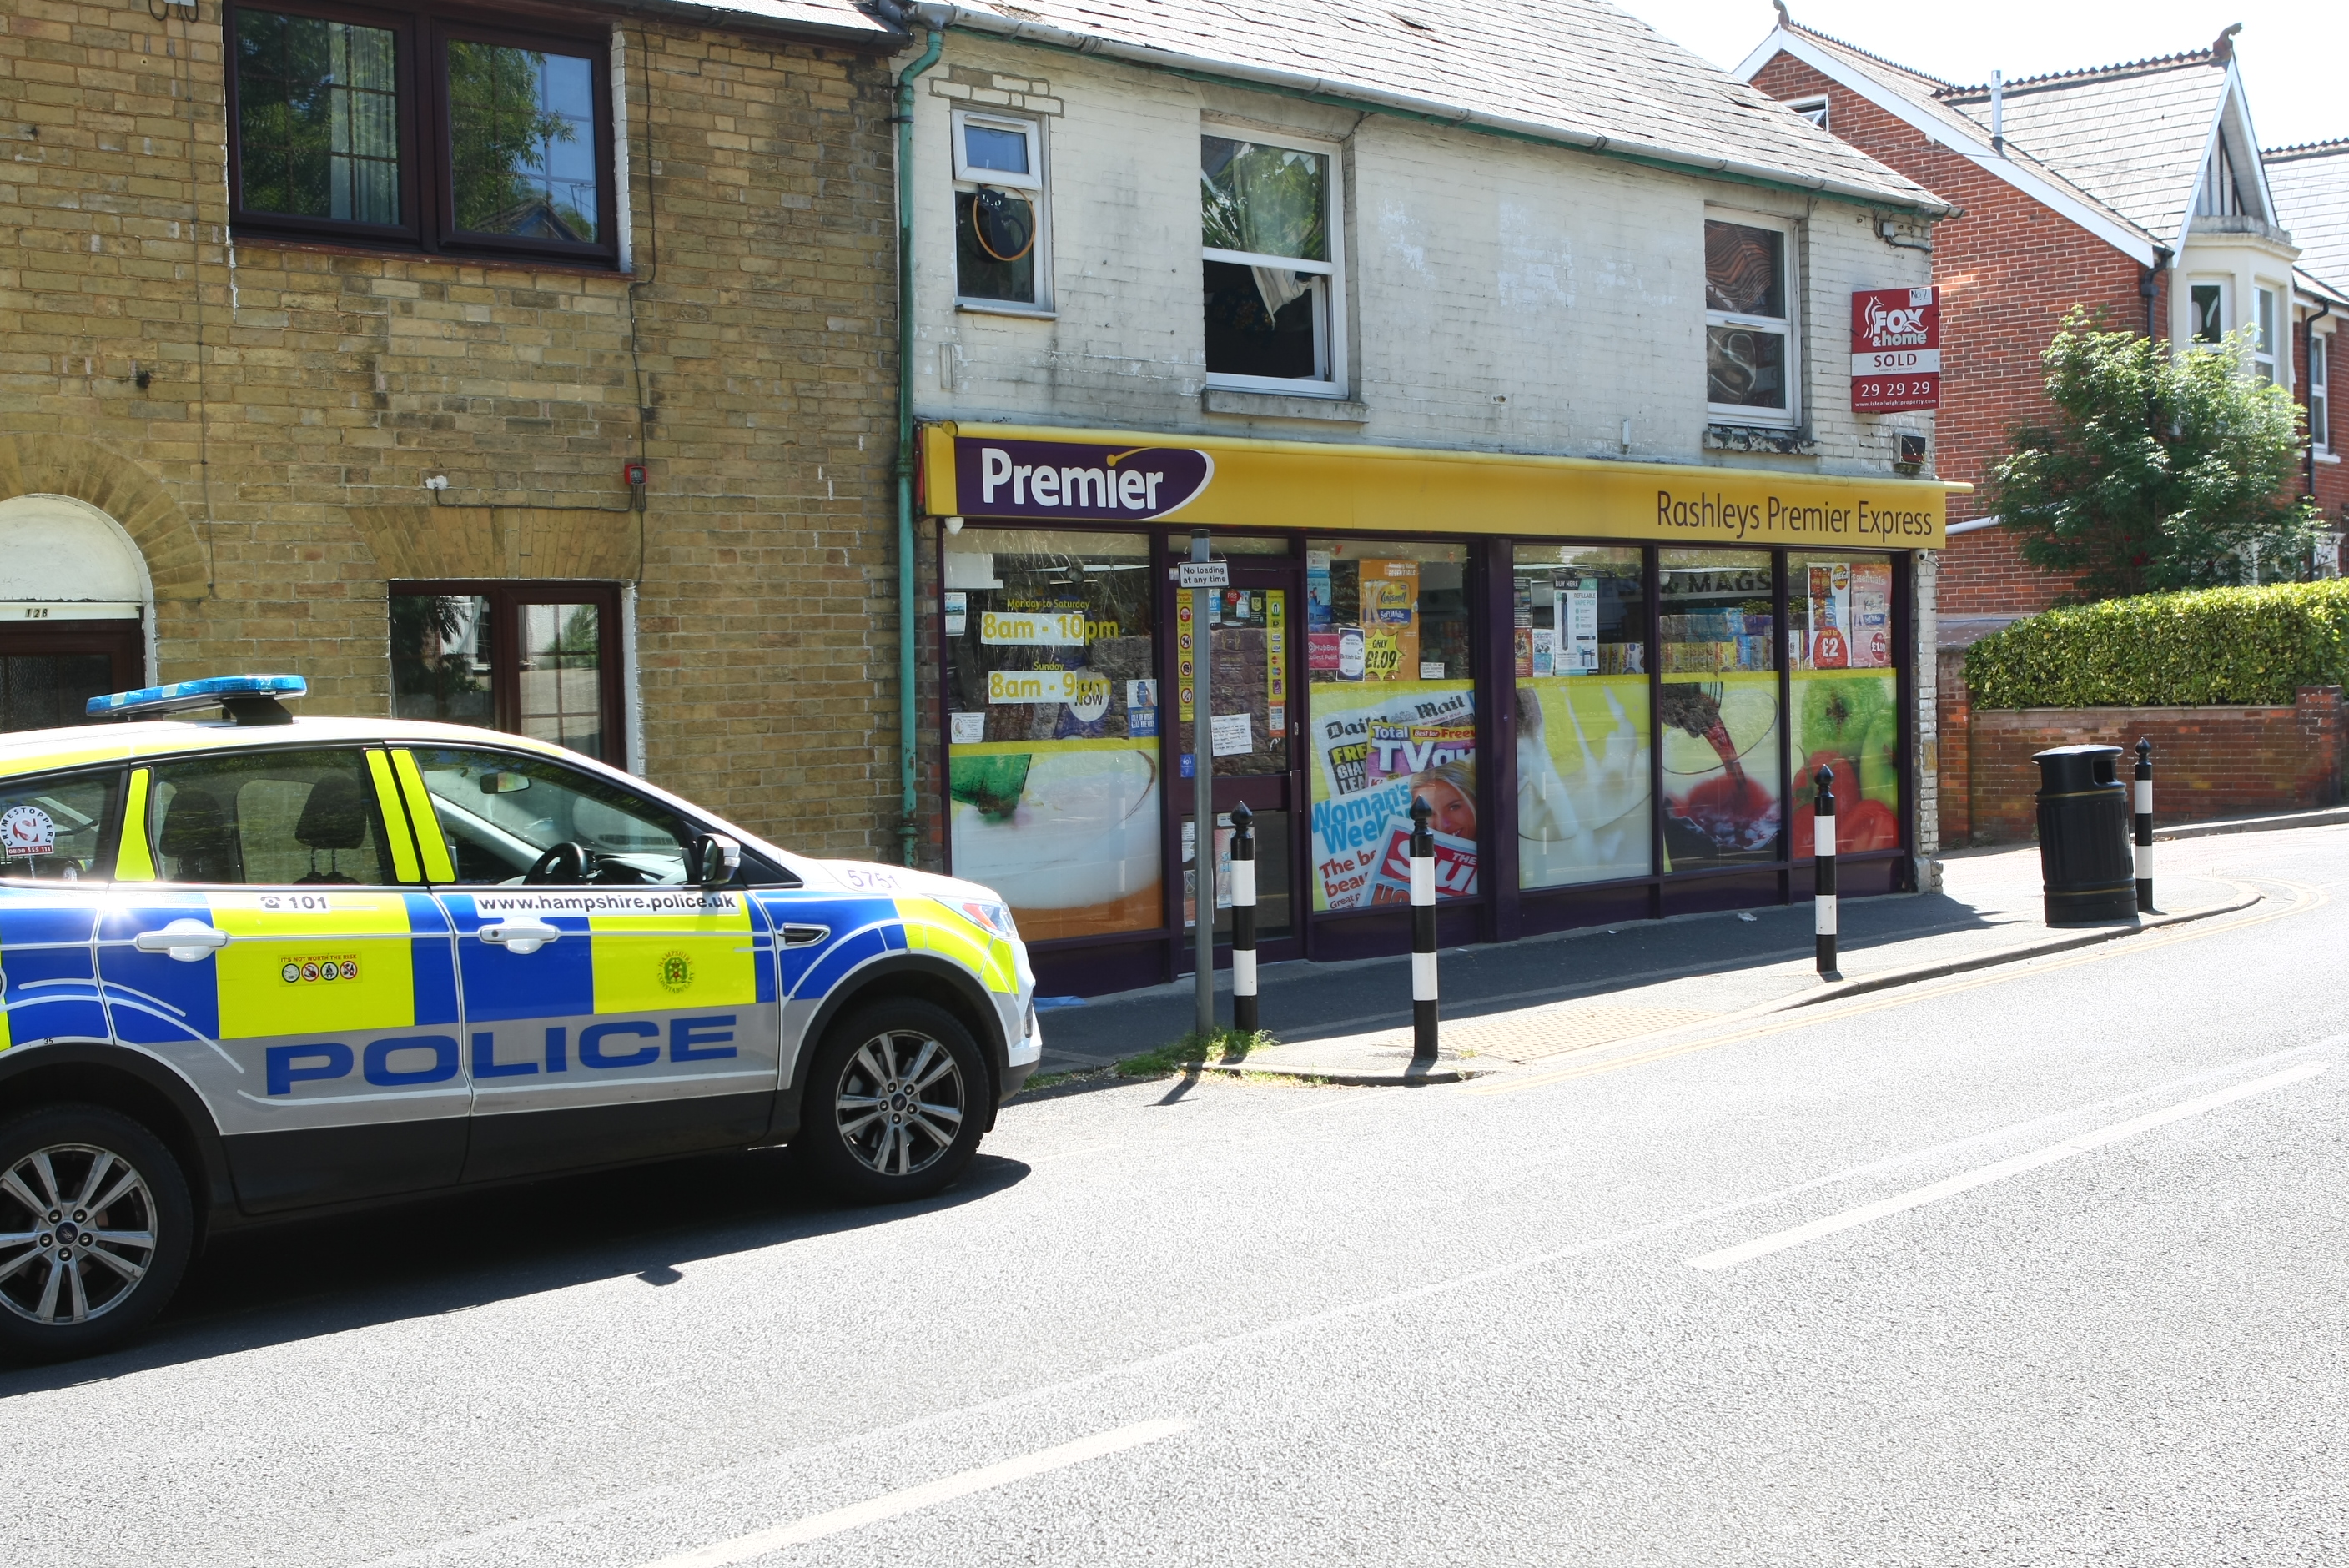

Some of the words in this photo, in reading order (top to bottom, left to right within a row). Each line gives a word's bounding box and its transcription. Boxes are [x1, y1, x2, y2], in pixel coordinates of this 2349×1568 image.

[1874, 308, 1925, 334] FOX
[1874, 353, 1917, 368] SOLD
[1861, 384, 1880, 397] 29
[1886, 382, 1905, 396] 29
[1911, 381, 1930, 395] 29
[1854, 399, 1936, 407] www.isleofwightproperty.com
[980, 447, 1164, 510] Premier
[1657, 490, 1760, 540] Rashleys
[1768, 496, 1851, 534] Premier
[1858, 500, 1933, 543] Express
[1196, 566, 1225, 575] loading
[26, 608, 48, 618] 128
[1007, 599, 1040, 610] Monday
[1043, 600, 1051, 608] to
[1054, 599, 1090, 611] Saturday
[983, 613, 1034, 639] 8am
[1057, 614, 1119, 646] 10pm
[1372, 639, 1388, 648] ONLY
[1822, 637, 1838, 657] £2
[1034, 661, 1064, 672] Sunday
[1365, 650, 1397, 669] £1.09
[989, 672, 1041, 698] 8am
[1062, 672, 1112, 704] 9pm
[1415, 695, 1466, 720] Mail
[1372, 724, 1409, 739] Total
[1414, 729, 1428, 737] Best
[1311, 783, 1413, 833] Woman's
[0, 807, 53, 847] CRIMESTOPPERS
[1453, 852, 1477, 865] THE
[1319, 858, 1356, 880] The
[846, 870, 902, 891] 5751
[289, 896, 327, 909] 101
[478, 893, 737, 912] www.hampshire.police.uk
[1330, 894, 1356, 909] Great
[657, 950, 694, 968] HAMPSHIRE
[266, 1014, 738, 1096] POLICE
